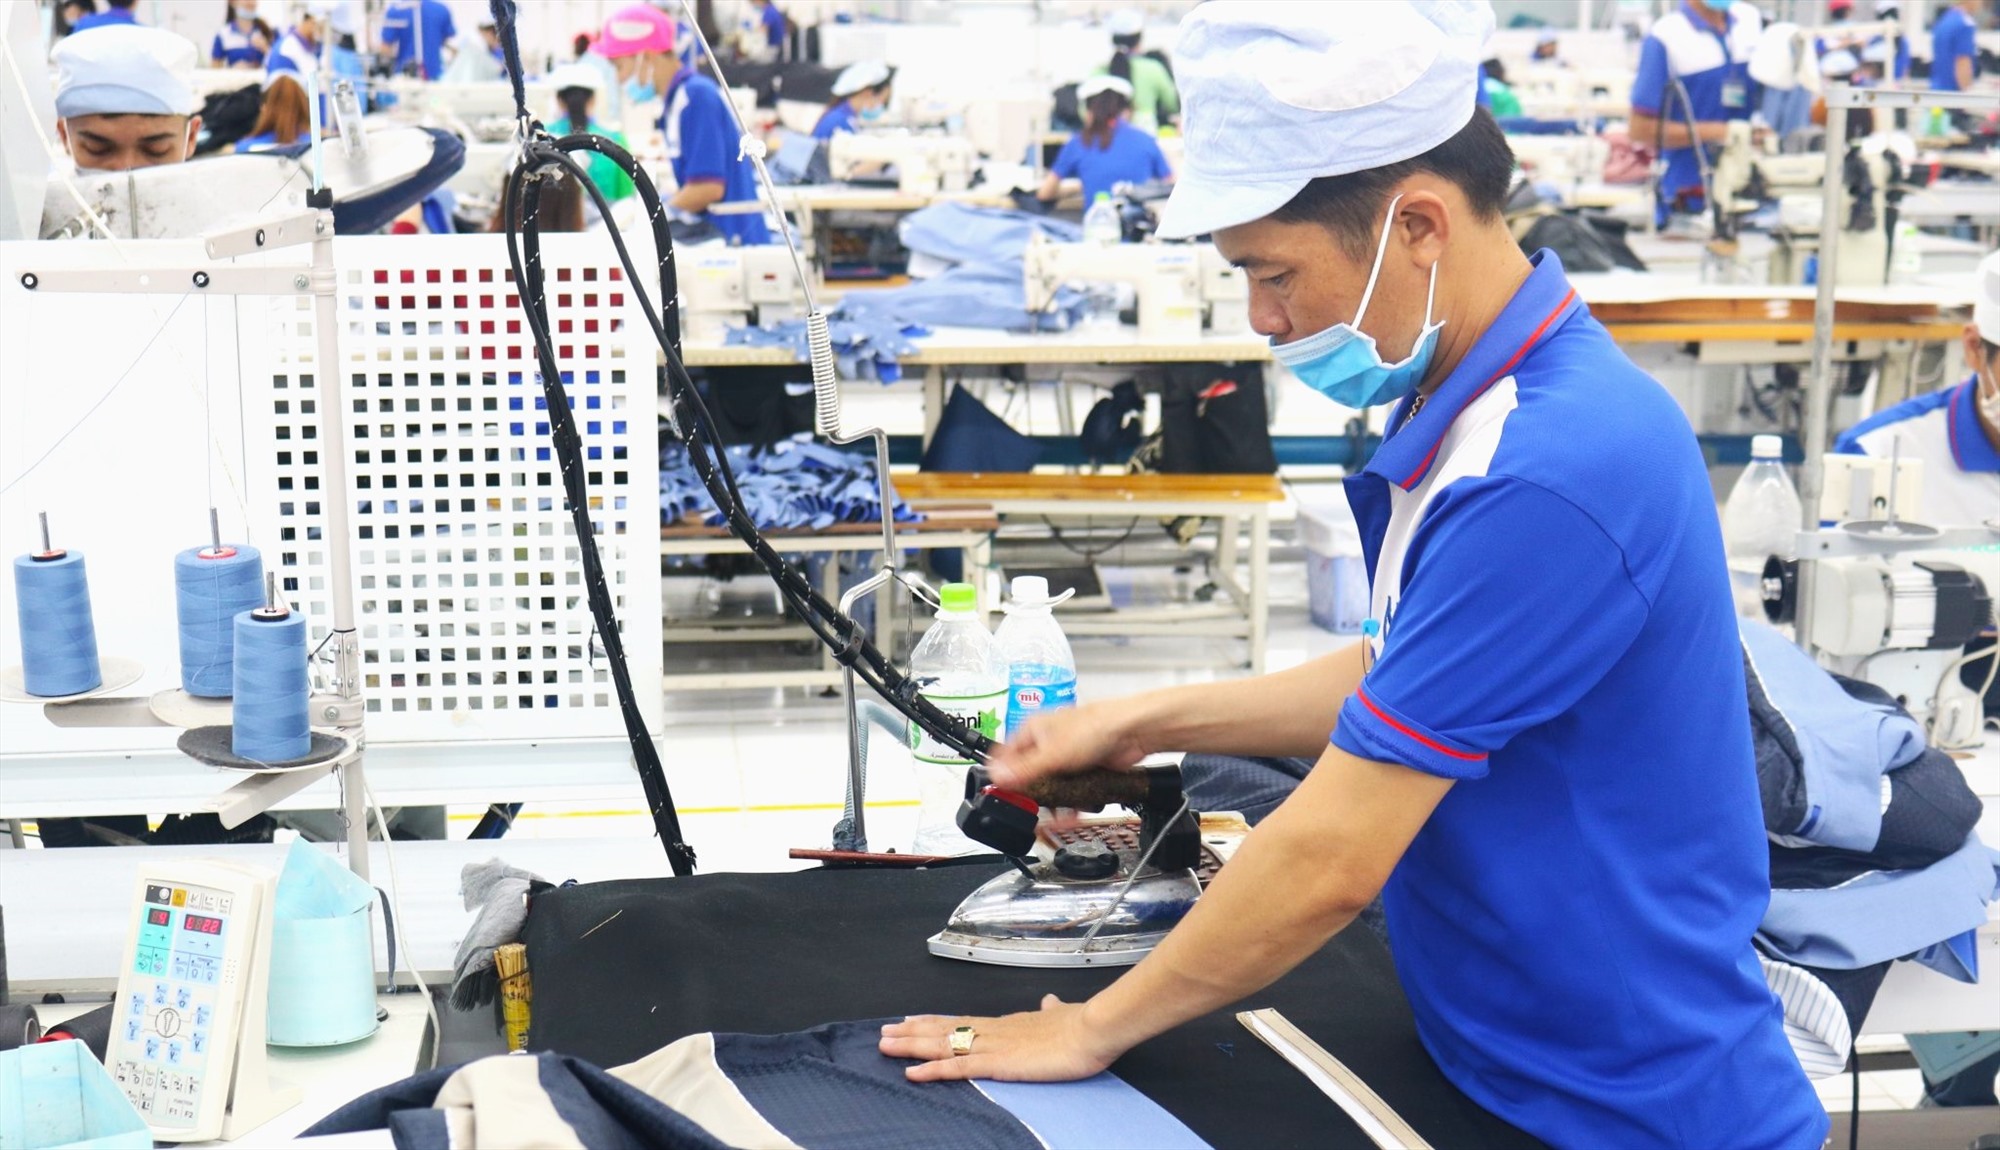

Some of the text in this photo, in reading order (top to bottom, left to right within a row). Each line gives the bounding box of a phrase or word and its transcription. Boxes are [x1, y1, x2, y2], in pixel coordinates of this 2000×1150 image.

[1020, 692, 1041, 702] mk
[169, 1107, 178, 1115] F1
[184, 1110, 194, 1119] F2
